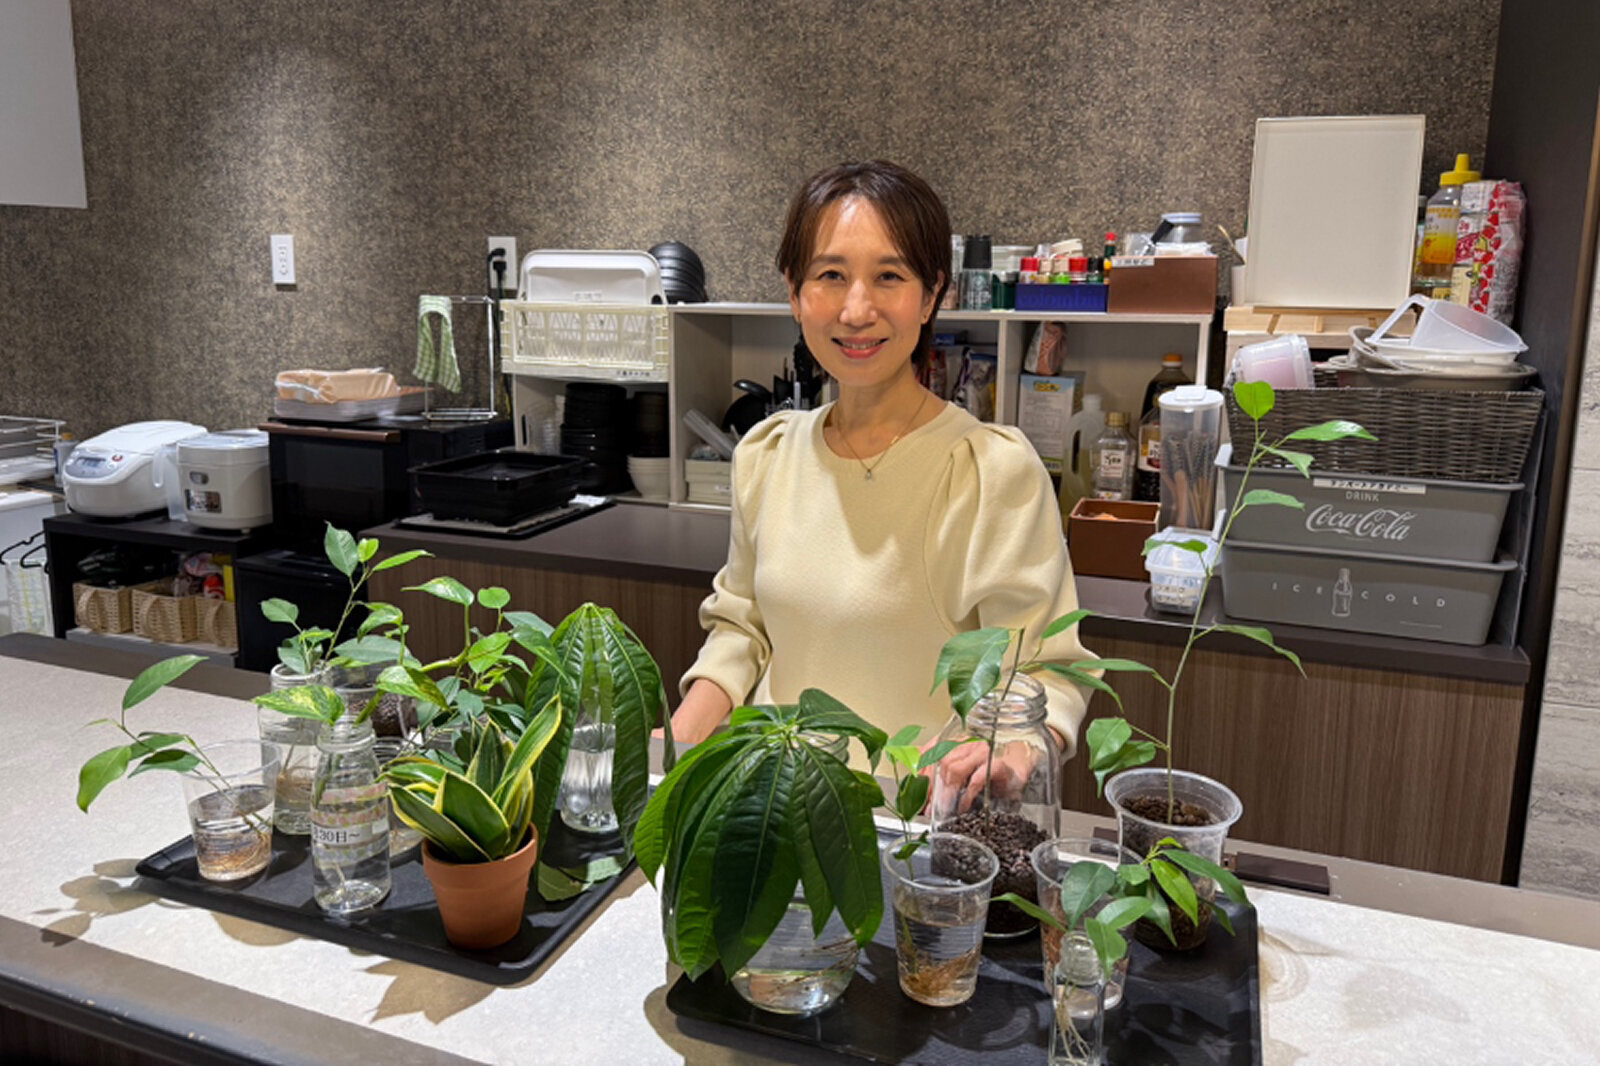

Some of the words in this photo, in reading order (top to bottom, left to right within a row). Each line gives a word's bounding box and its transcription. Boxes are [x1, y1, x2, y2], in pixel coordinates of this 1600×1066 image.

[1345, 491, 1379, 502] DRINK
[1306, 504, 1417, 540] Coca-Cola
[1272, 582, 1322, 594] ICE
[1361, 590, 1446, 607] COLD
